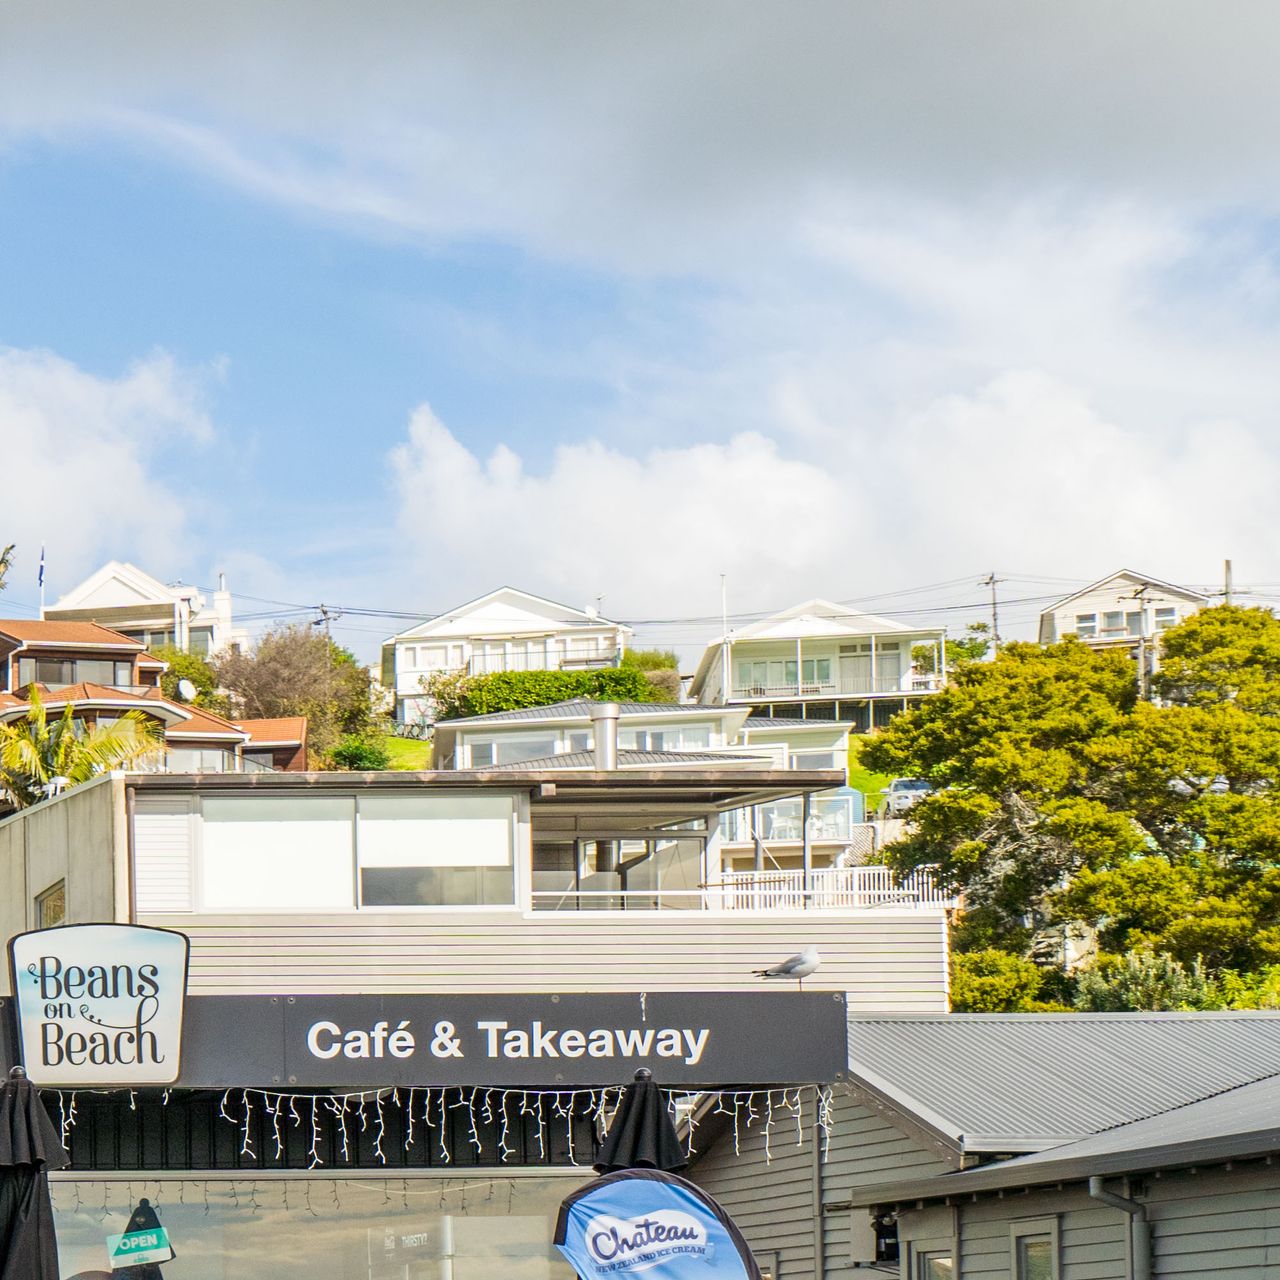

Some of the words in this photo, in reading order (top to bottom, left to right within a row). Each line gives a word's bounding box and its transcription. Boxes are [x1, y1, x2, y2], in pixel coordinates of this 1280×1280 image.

[27, 956, 160, 1000] Beans
[44, 1002, 76, 1020] on
[41, 996, 166, 1067] Beach
[306, 1019, 416, 1059] Café
[430, 1021, 465, 1058] &
[477, 1020, 710, 1066] Takeaway
[120, 1234, 158, 1250] OPEN
[401, 1233, 428, 1249] THIRSTY?
[592, 1218, 699, 1261] Chateau
[595, 1263, 616, 1273] NEW
[616, 1252, 656, 1270] ZEALAND
[657, 1248, 672, 1257] ICE
[671, 1245, 706, 1255] CREAM
